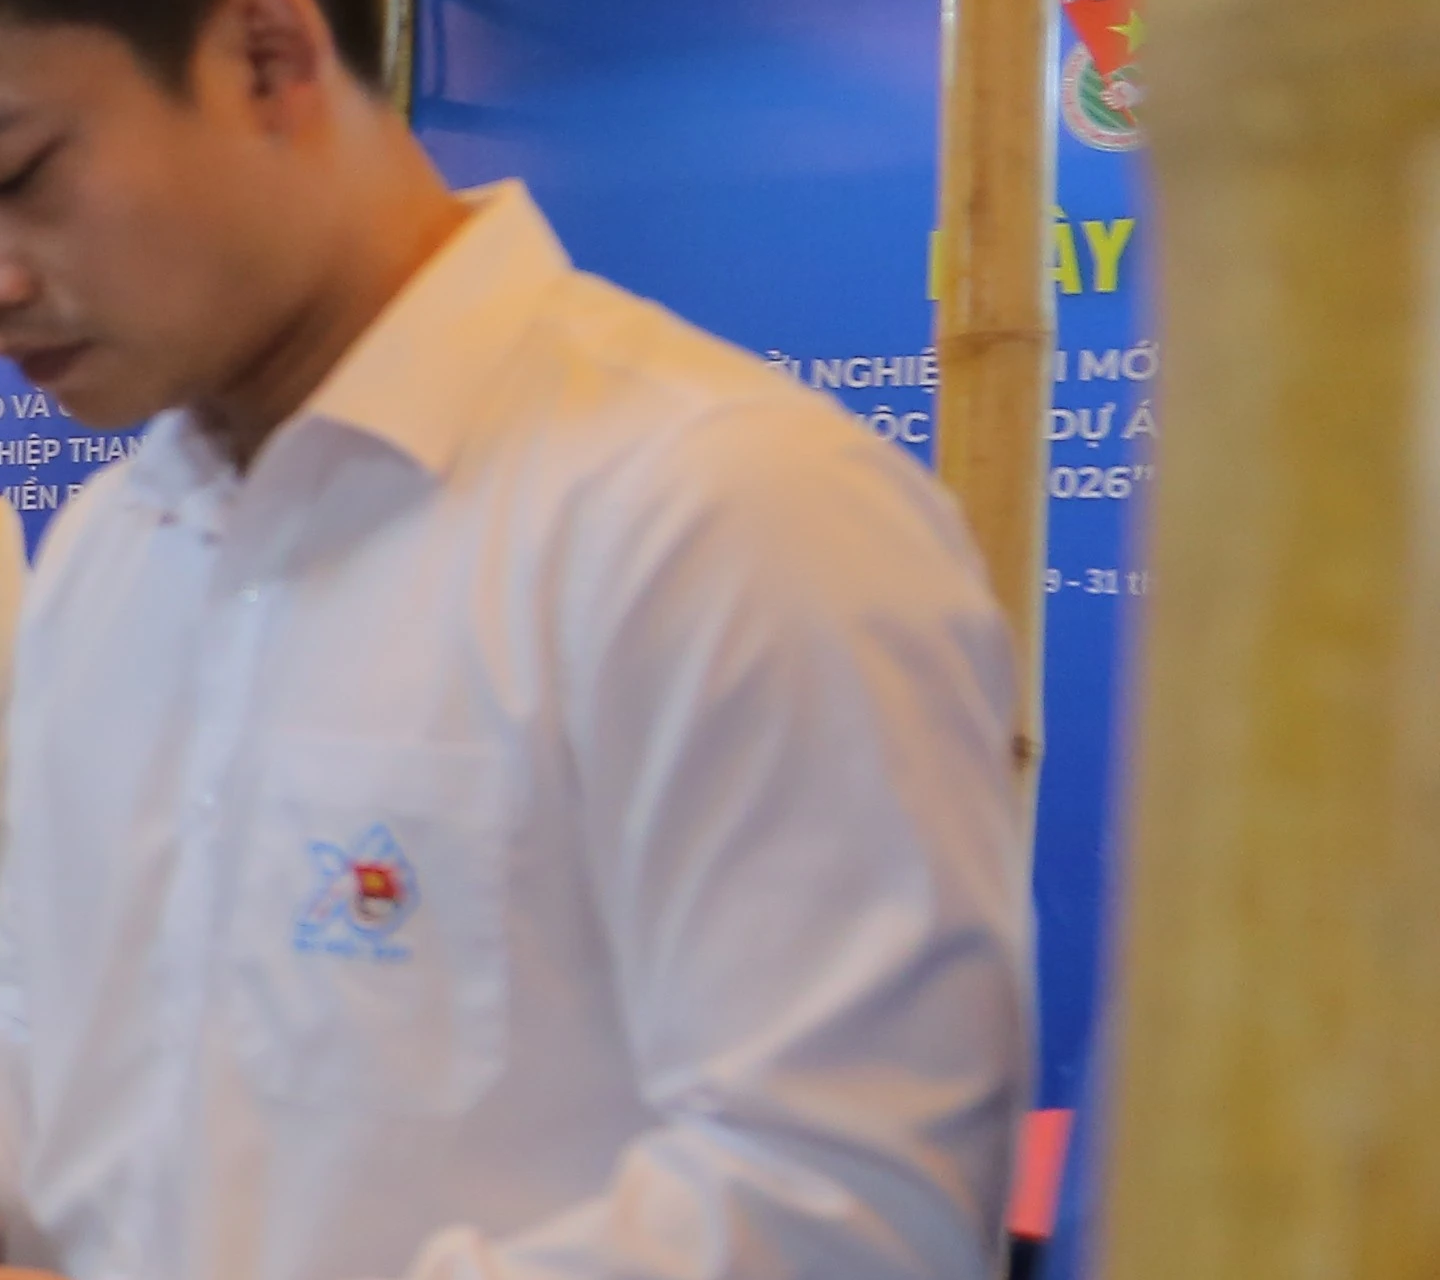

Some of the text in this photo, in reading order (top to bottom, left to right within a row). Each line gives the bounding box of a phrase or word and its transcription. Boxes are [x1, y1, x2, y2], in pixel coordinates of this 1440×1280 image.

[811, 346, 941, 394] NGHIỆ
[1078, 340, 1161, 381] MỚ
[11, 387, 50, 419] VÀ
[1049, 465, 1155, 500] 026”
[1043, 568, 1062, 594] 9
